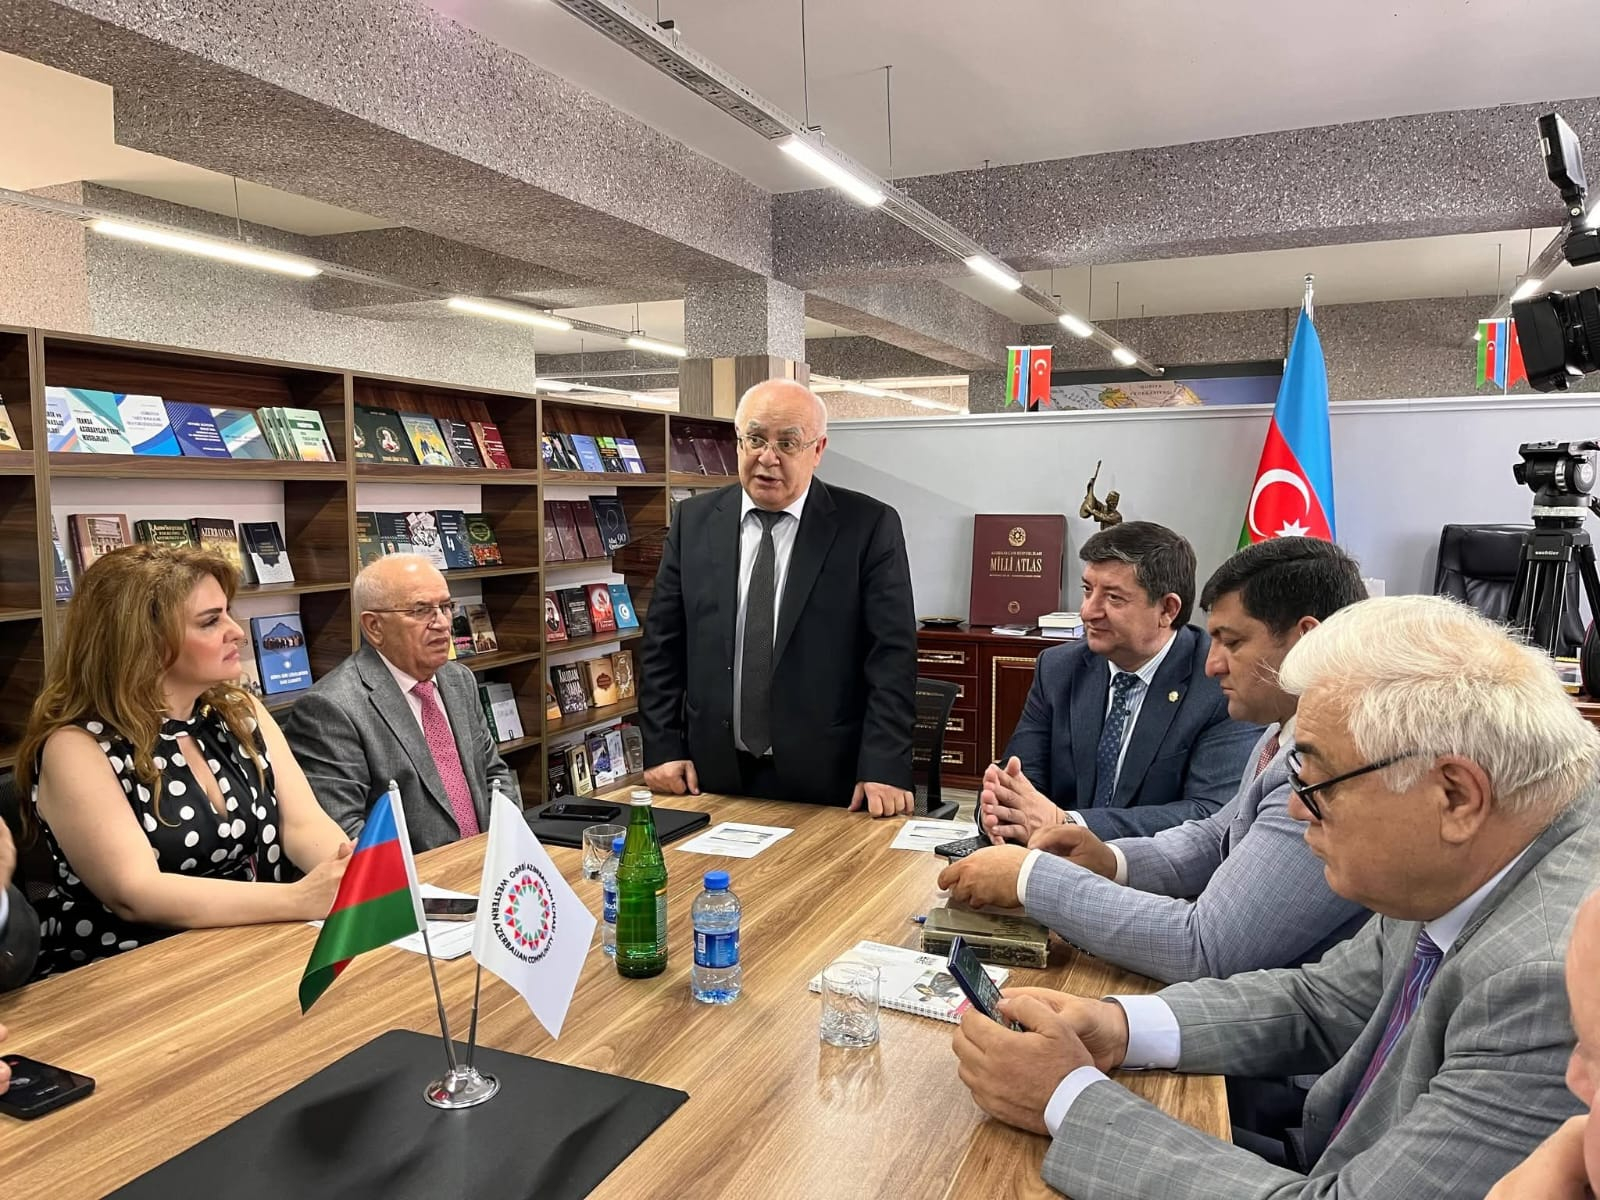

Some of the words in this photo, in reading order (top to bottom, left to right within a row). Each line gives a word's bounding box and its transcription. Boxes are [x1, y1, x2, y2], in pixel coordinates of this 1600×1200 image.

[990, 556, 1013, 572] MİLLİ
[1015, 558, 1042, 572] ATLAS
[491, 879, 510, 921] WESTERN
[493, 922, 527, 963] AZERBAIJAN
